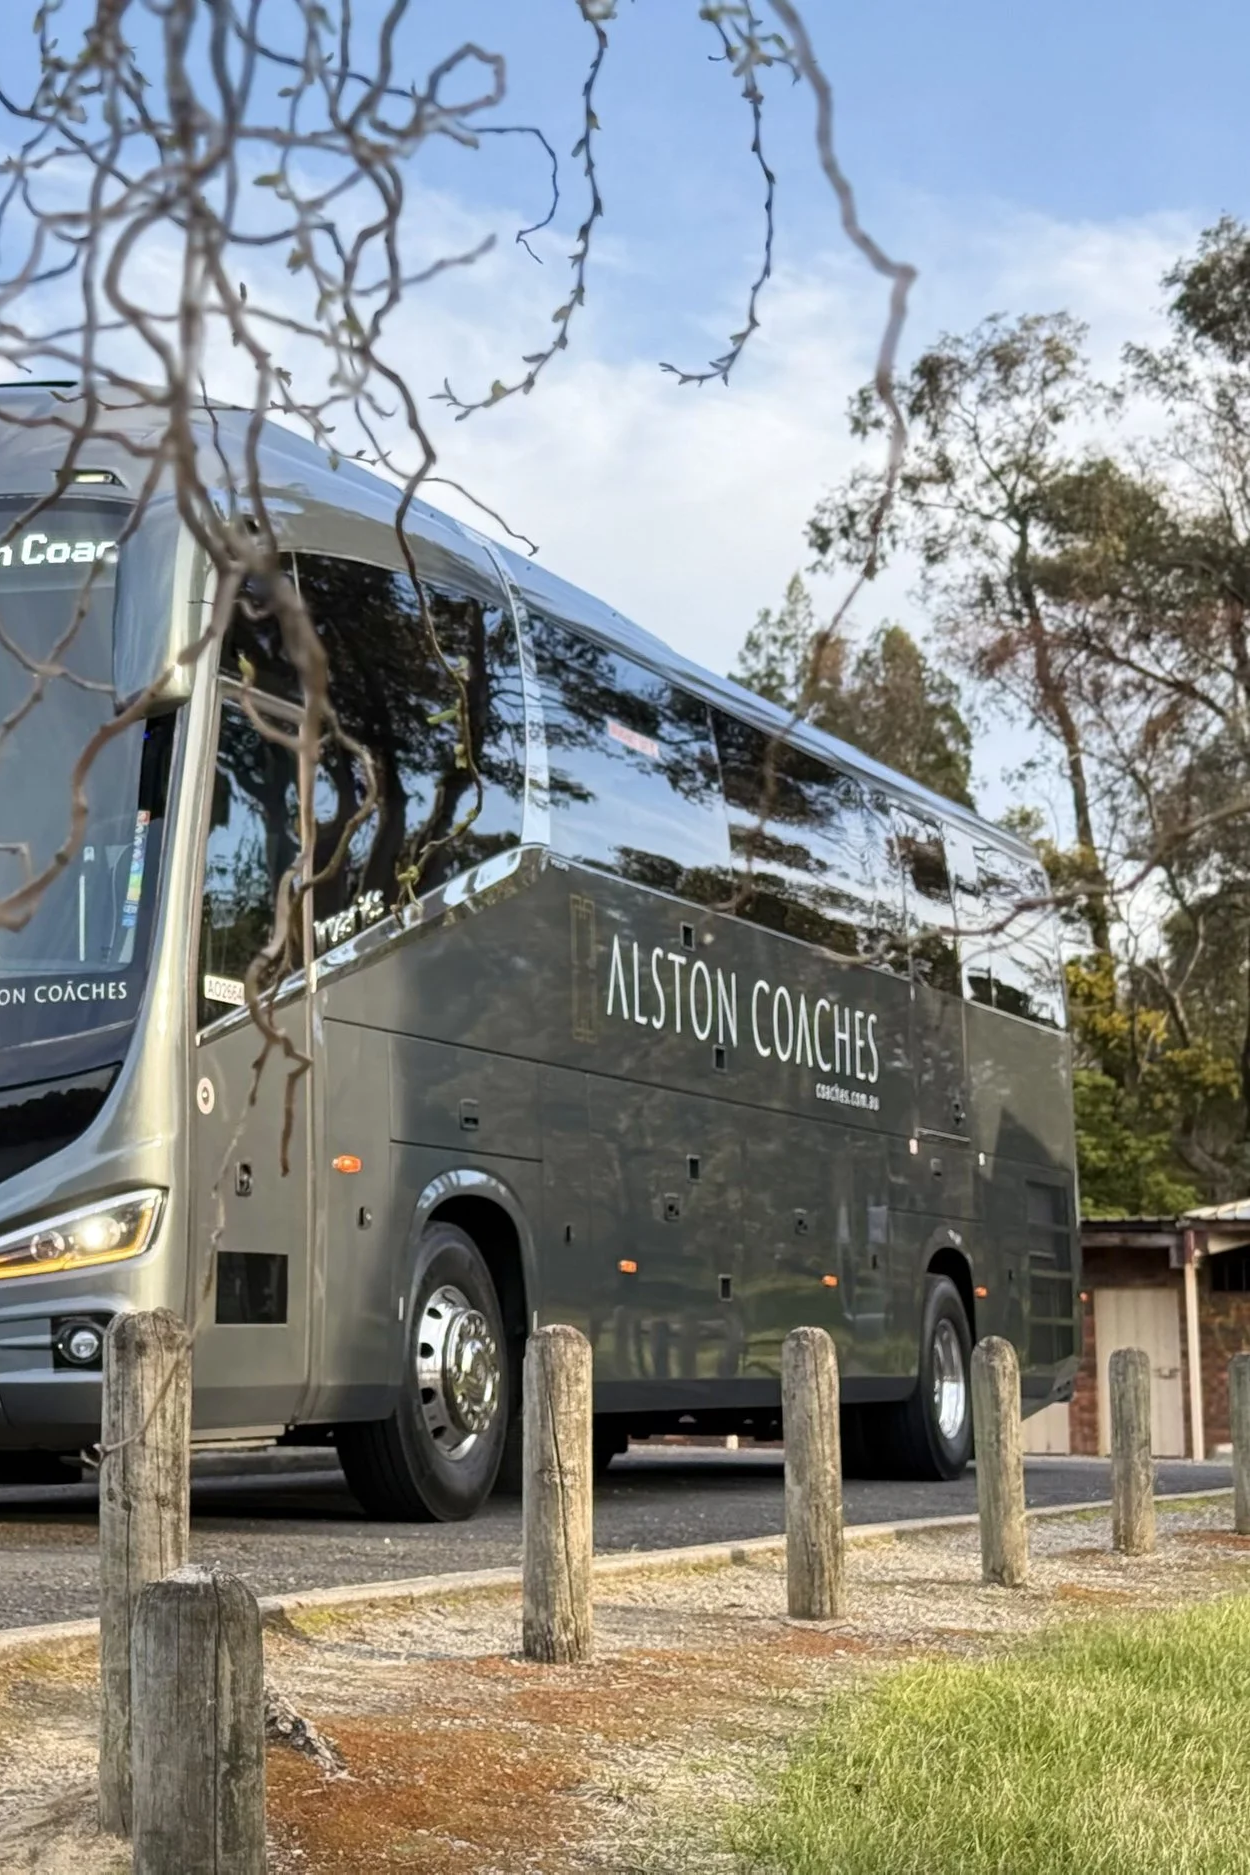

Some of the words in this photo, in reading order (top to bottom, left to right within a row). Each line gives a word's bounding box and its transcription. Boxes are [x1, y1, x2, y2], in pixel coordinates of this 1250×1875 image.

[34, 980, 128, 1004] COACHES
[607, 933, 738, 1048] ALSTON
[751, 979, 880, 1083] COACHES
[815, 1082, 880, 1111] coaches.com.au
